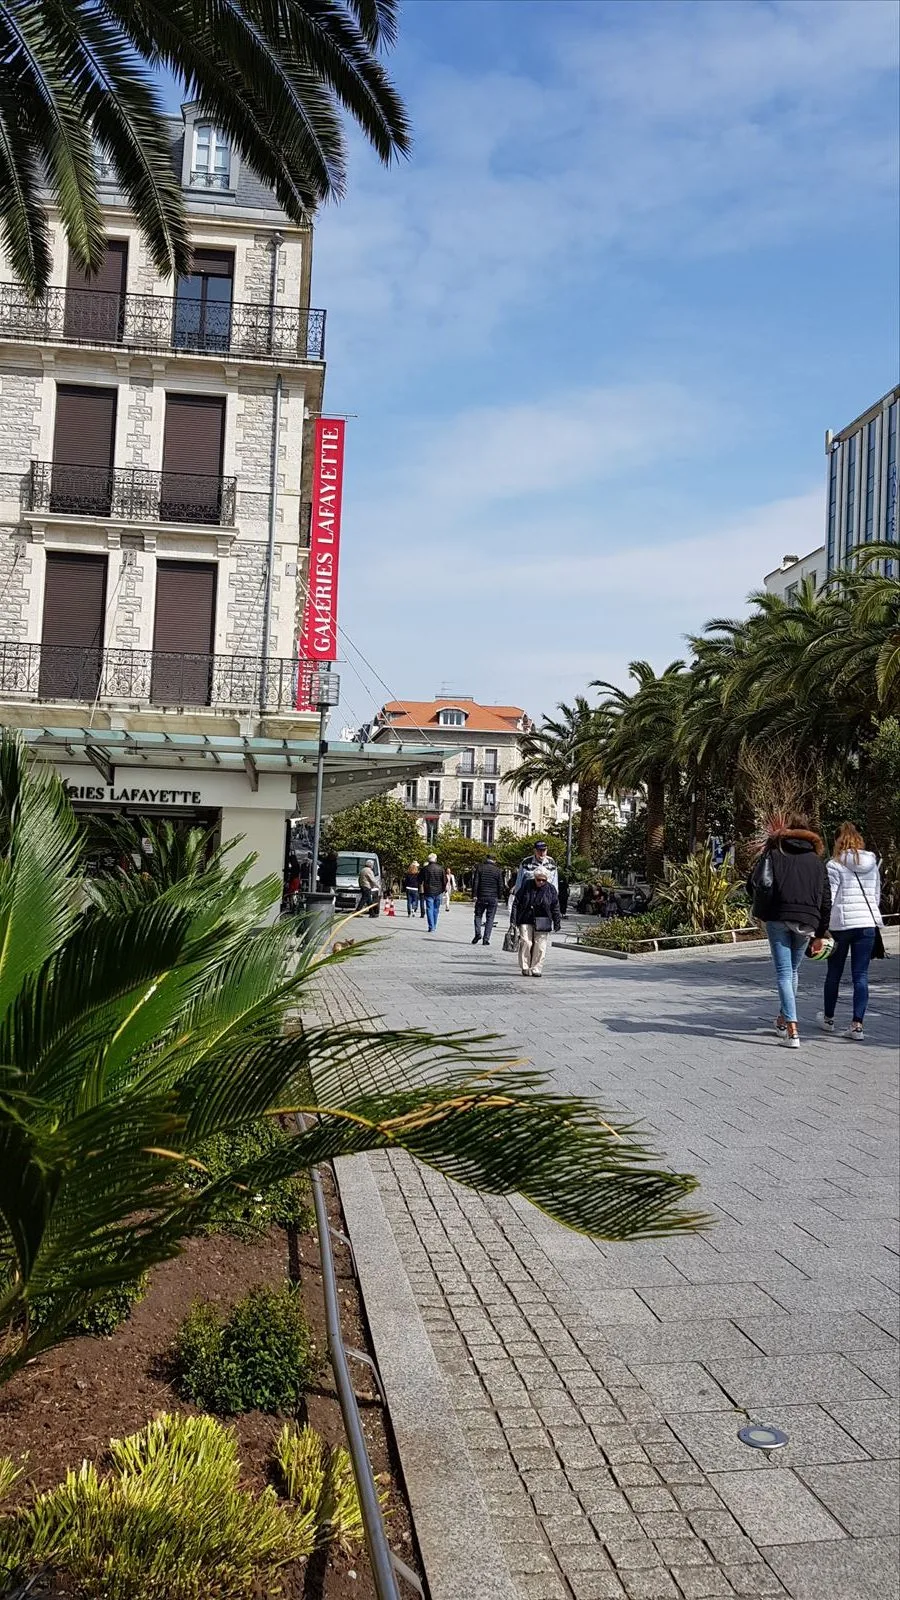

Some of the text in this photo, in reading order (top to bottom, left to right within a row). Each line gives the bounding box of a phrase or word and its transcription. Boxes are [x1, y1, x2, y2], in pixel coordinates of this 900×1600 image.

[313, 428, 339, 652] GALERIES LAFAYETTE
[68, 785, 201, 803] RIES LAFAYETTE
